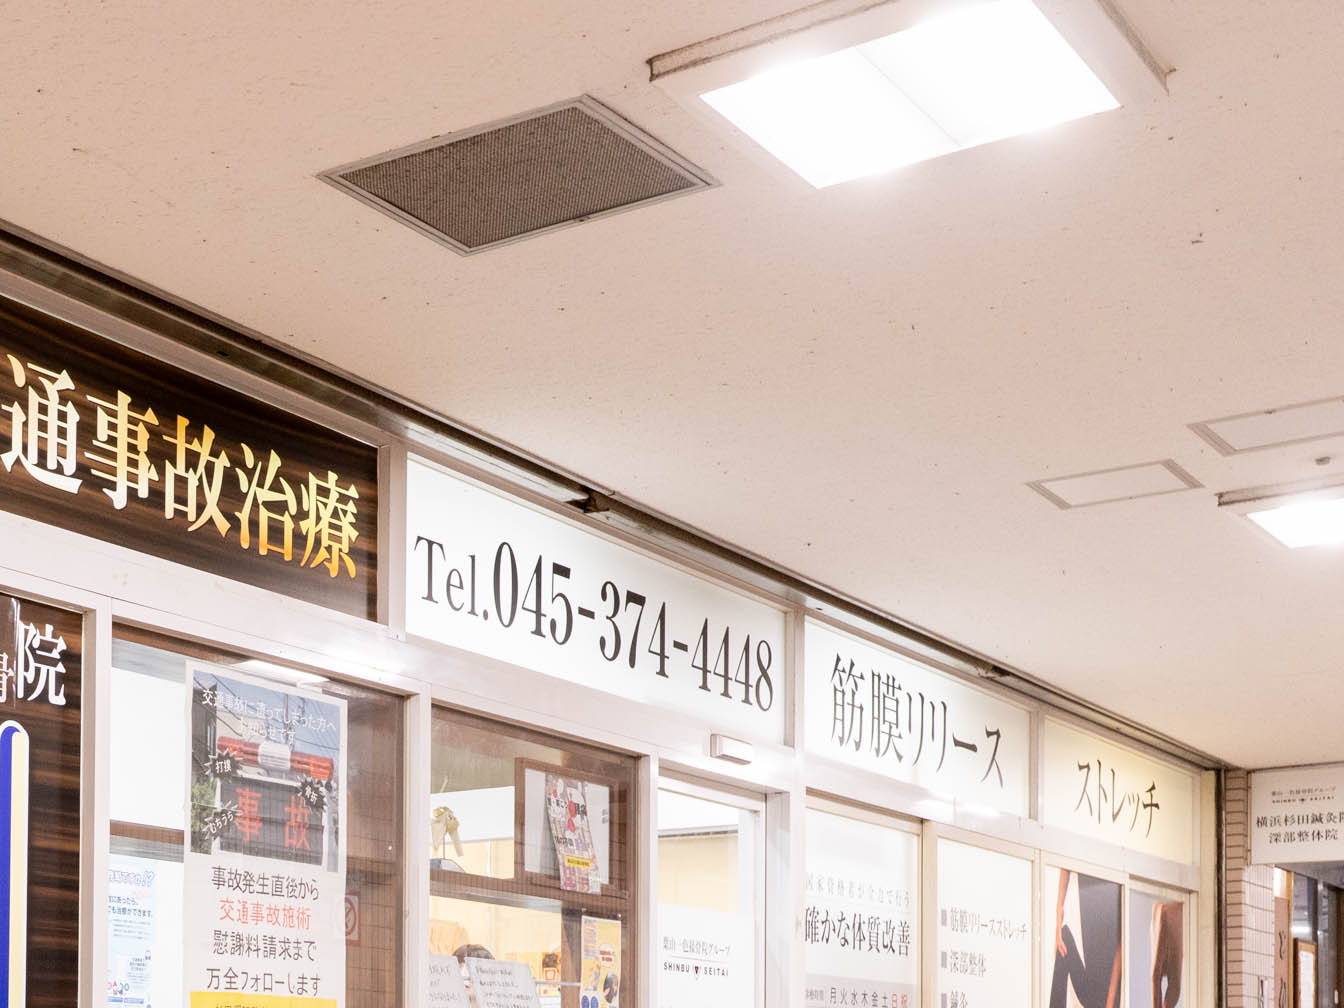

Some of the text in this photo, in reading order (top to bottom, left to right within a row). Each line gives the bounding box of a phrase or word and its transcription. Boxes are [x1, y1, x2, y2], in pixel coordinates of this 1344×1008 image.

[414, 535, 773, 712] Tel.045-374-4448
[17, 620, 68, 706] 院
[830, 652, 1004, 788] 筋膜リリース
[1074, 759, 1160, 838] ストレッチ
[211, 864, 320, 901] 事故発生直後から
[218, 898, 312, 931] 交通事故施術
[212, 929, 317, 962] 慰謝料請求まで
[206, 966, 321, 997] 万全フォローします
[663, 961, 729, 977] SHINBU SEITAI
